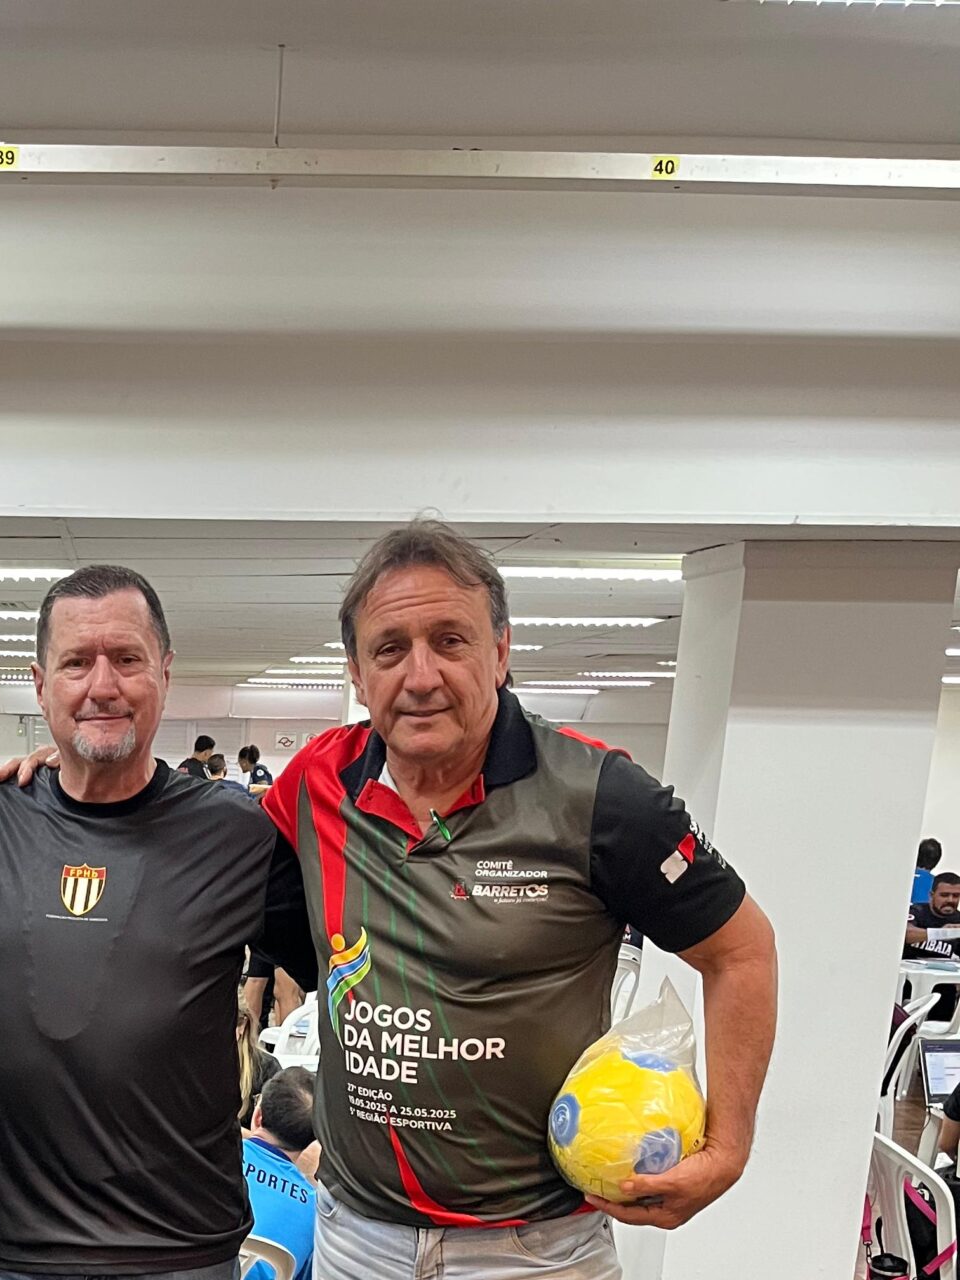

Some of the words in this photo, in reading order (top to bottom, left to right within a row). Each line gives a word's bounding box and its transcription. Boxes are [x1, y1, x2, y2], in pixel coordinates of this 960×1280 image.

[653, 159, 675, 175] 40
[476, 859, 513, 870] COMITÊ
[474, 869, 548, 878] ORGANIZADOR
[471, 883, 549, 898] BARRETOS
[344, 998, 432, 1032] JOGOS
[344, 1023, 375, 1052] DA
[380, 1031, 507, 1061] MELHOR
[345, 1049, 419, 1084] IDADE
[357, 1086, 393, 1101] EDIÇÃO
[389, 1105, 398, 1114] A
[400, 1106, 457, 1119] 25.05.2025
[356, 1110, 388, 1125] REGIÃO
[389, 1117, 453, 1131] ESPORTIVA
[243, 1160, 309, 1204] PORTES
